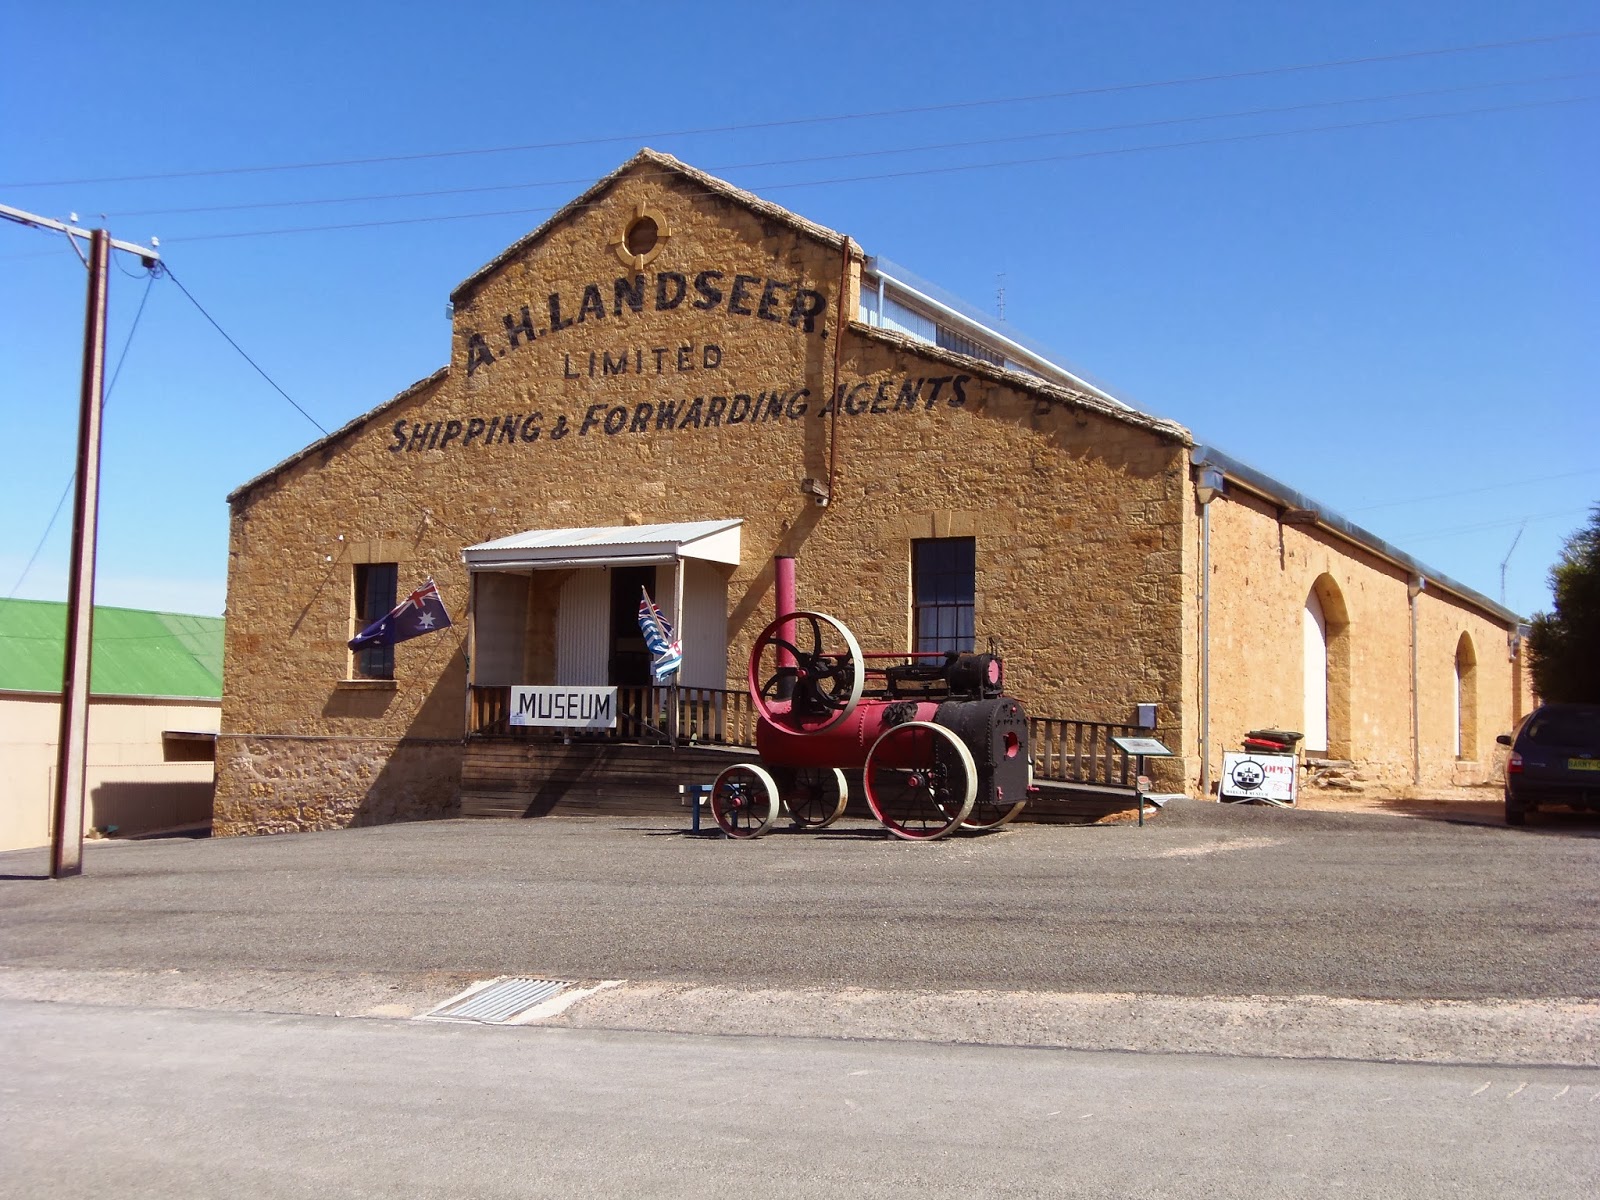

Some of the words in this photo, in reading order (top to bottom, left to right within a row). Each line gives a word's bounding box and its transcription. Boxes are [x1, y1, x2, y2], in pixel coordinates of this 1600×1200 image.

[564, 344, 722, 380] LIMITED
[388, 411, 543, 452] SHIPPING
[550, 414, 570, 441] &
[579, 388, 811, 437] FORWARDING
[817, 375, 972, 418] AGENTS
[519, 693, 610, 719] MUSEUM
